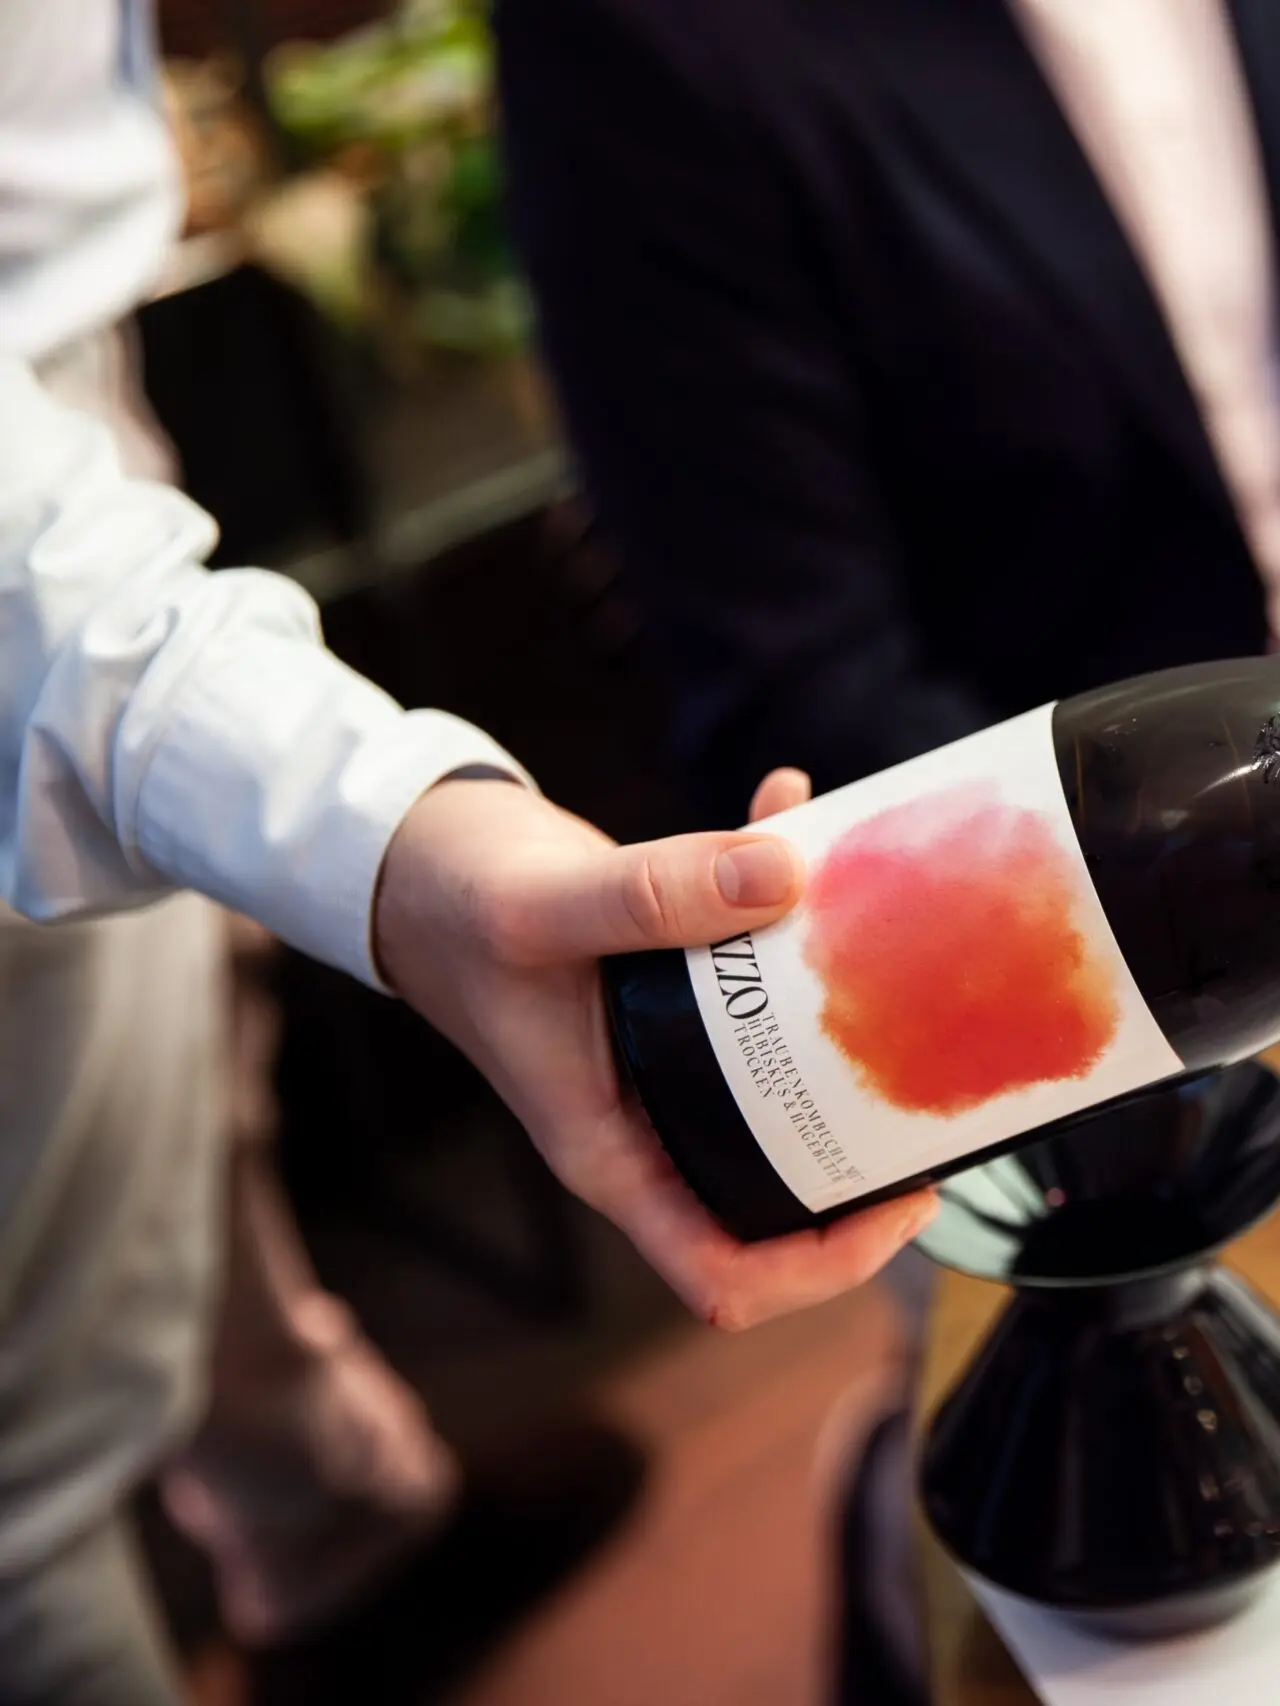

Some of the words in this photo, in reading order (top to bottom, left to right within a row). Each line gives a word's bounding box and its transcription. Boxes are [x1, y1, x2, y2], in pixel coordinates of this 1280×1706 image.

[734, 1023, 774, 1099] TROCKEN
[747, 1018, 791, 1098] HIBISKUS
[783, 1101, 793, 1112] &
[762, 1011, 847, 1164] TRAUBENKOMBUCHA
